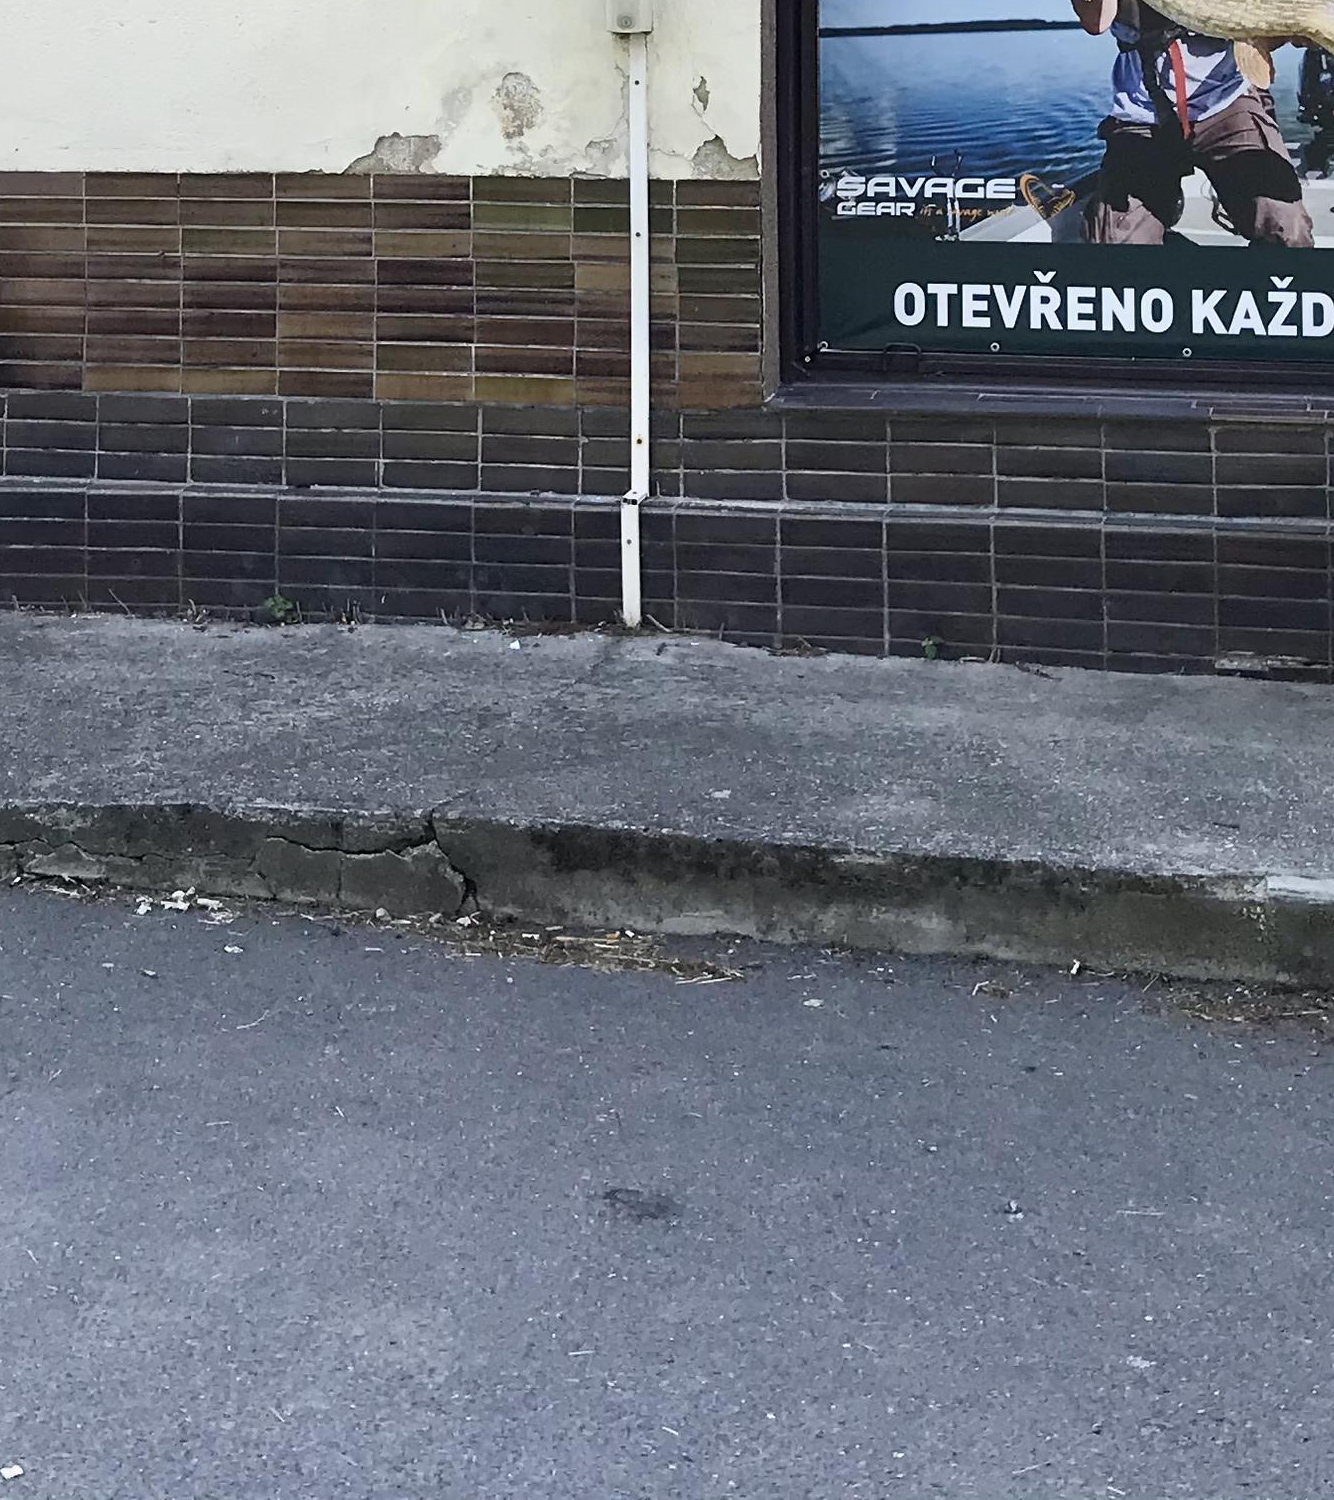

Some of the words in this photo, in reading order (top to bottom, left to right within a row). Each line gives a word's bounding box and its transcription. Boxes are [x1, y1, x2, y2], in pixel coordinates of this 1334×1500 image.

[836, 177, 1016, 200] SAVAGE
[836, 201, 916, 217] GEAR
[893, 269, 1175, 333] OTEVŘENO
